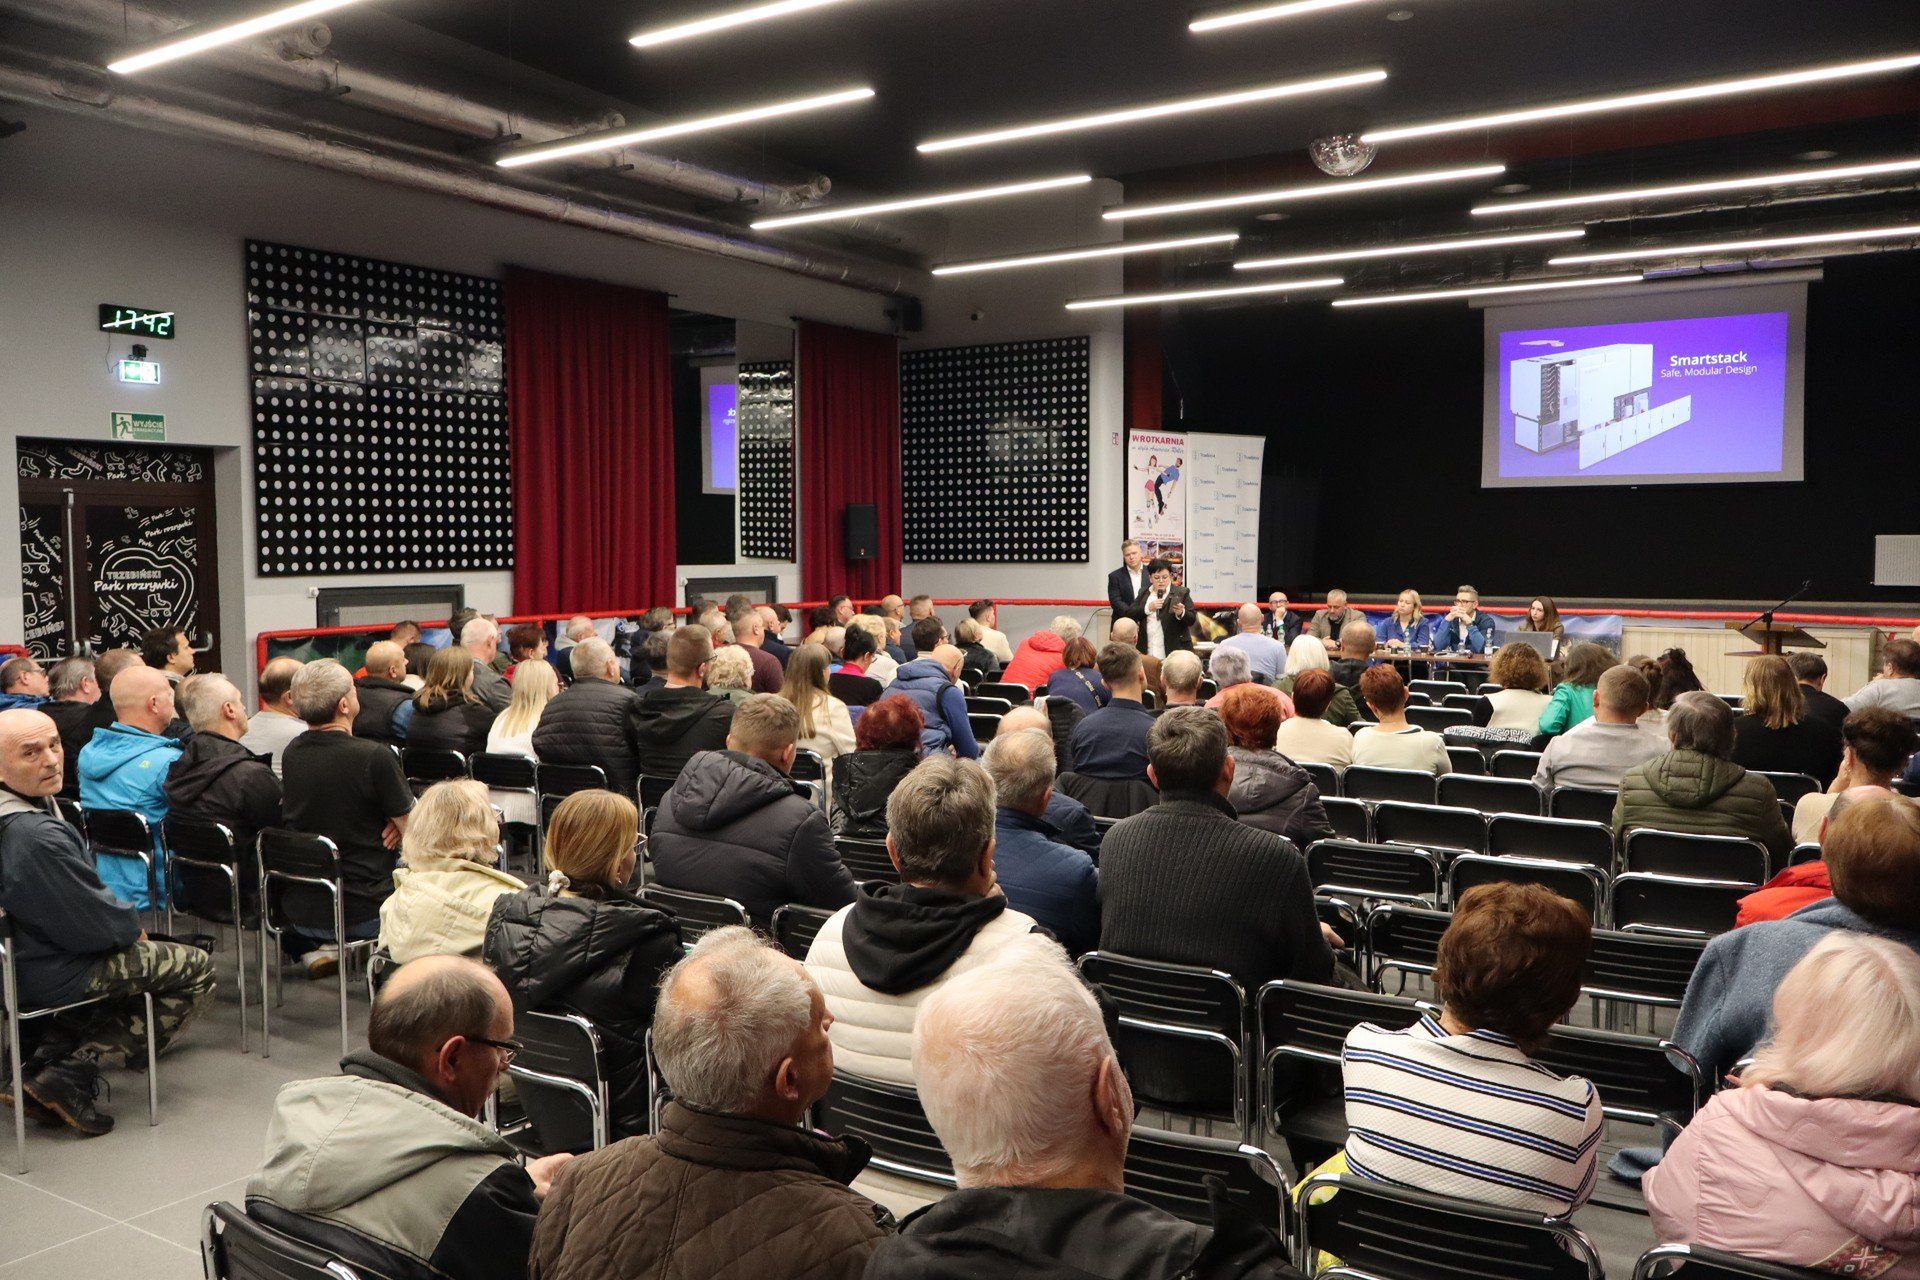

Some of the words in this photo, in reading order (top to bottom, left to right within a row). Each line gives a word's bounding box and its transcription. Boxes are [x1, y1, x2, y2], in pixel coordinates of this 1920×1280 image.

[1670, 350, 1748, 366] Smartstack
[1660, 368, 1682, 378] Safe,
[1684, 366, 1723, 377] Modular
[1725, 364, 1758, 376] Design
[1132, 435, 1184, 446] WROTKARNIA
[106, 471, 128, 481] Park
[144, 528, 163, 539] Park
[106, 569, 162, 580] TRZEBIŃSKI
[93, 580, 125, 592] Park
[126, 578, 178, 592] rozrywki
